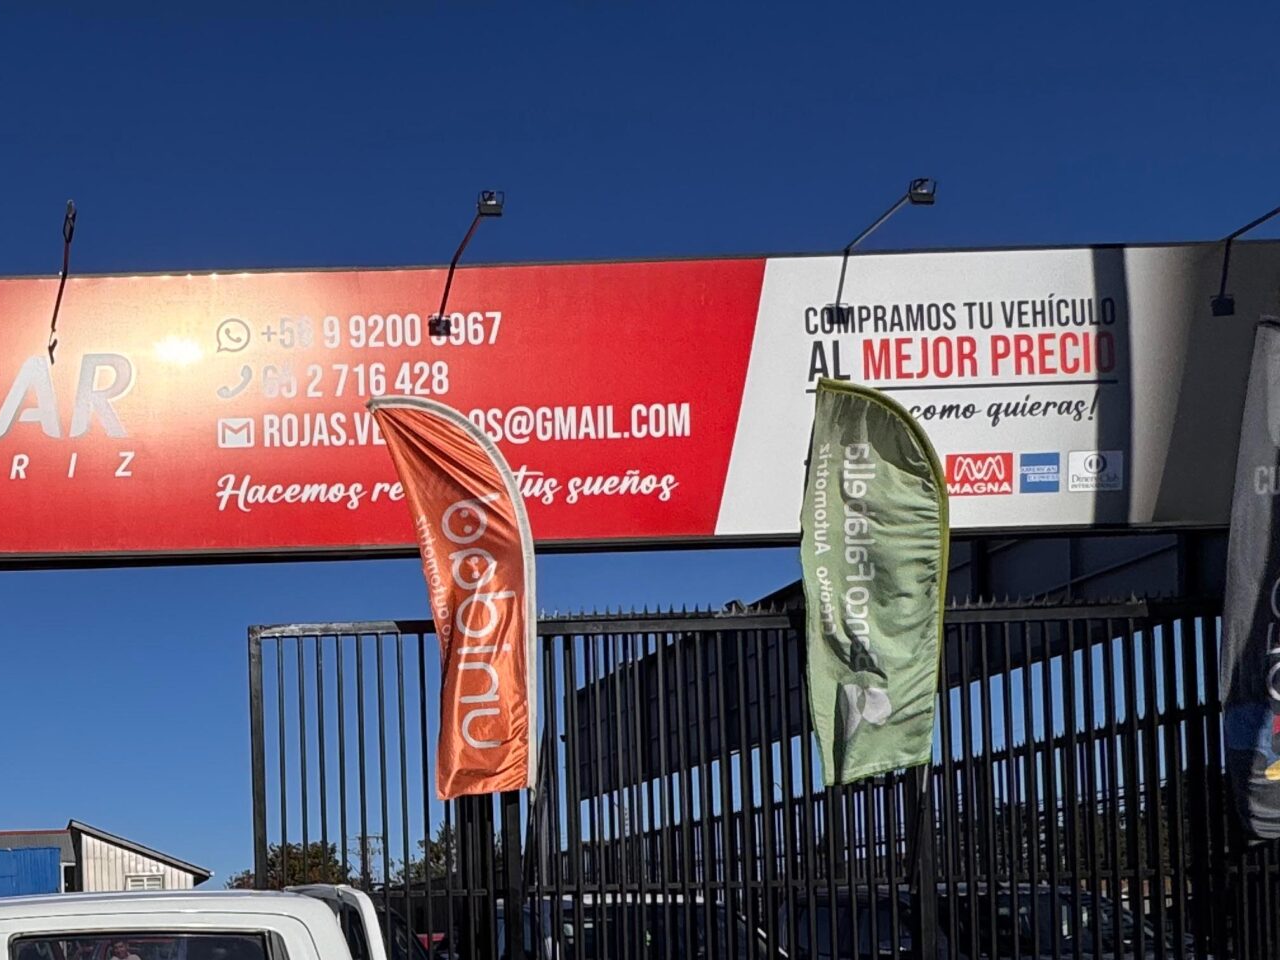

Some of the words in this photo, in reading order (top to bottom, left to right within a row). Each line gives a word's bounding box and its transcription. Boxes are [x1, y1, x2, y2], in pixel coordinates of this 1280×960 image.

[323, 315, 340, 349] 9
[349, 313, 421, 348] 9200
[429, 311, 502, 346] 967
[805, 302, 956, 335] COMPRAMOS
[963, 301, 993, 329] TU
[1001, 293, 1116, 328] VEHÍCULO
[808, 340, 851, 382] AL
[863, 336, 978, 380] MEJOR
[990, 331, 1115, 376] PRECIO
[307, 364, 323, 398] 2
[332, 362, 386, 396] 716
[394, 360, 449, 395] 428
[987, 388, 1100, 427] quieras!
[216, 473, 367, 512] Hacemos
[566, 469, 679, 505] sueños
[947, 483, 1012, 494] MAGNA
